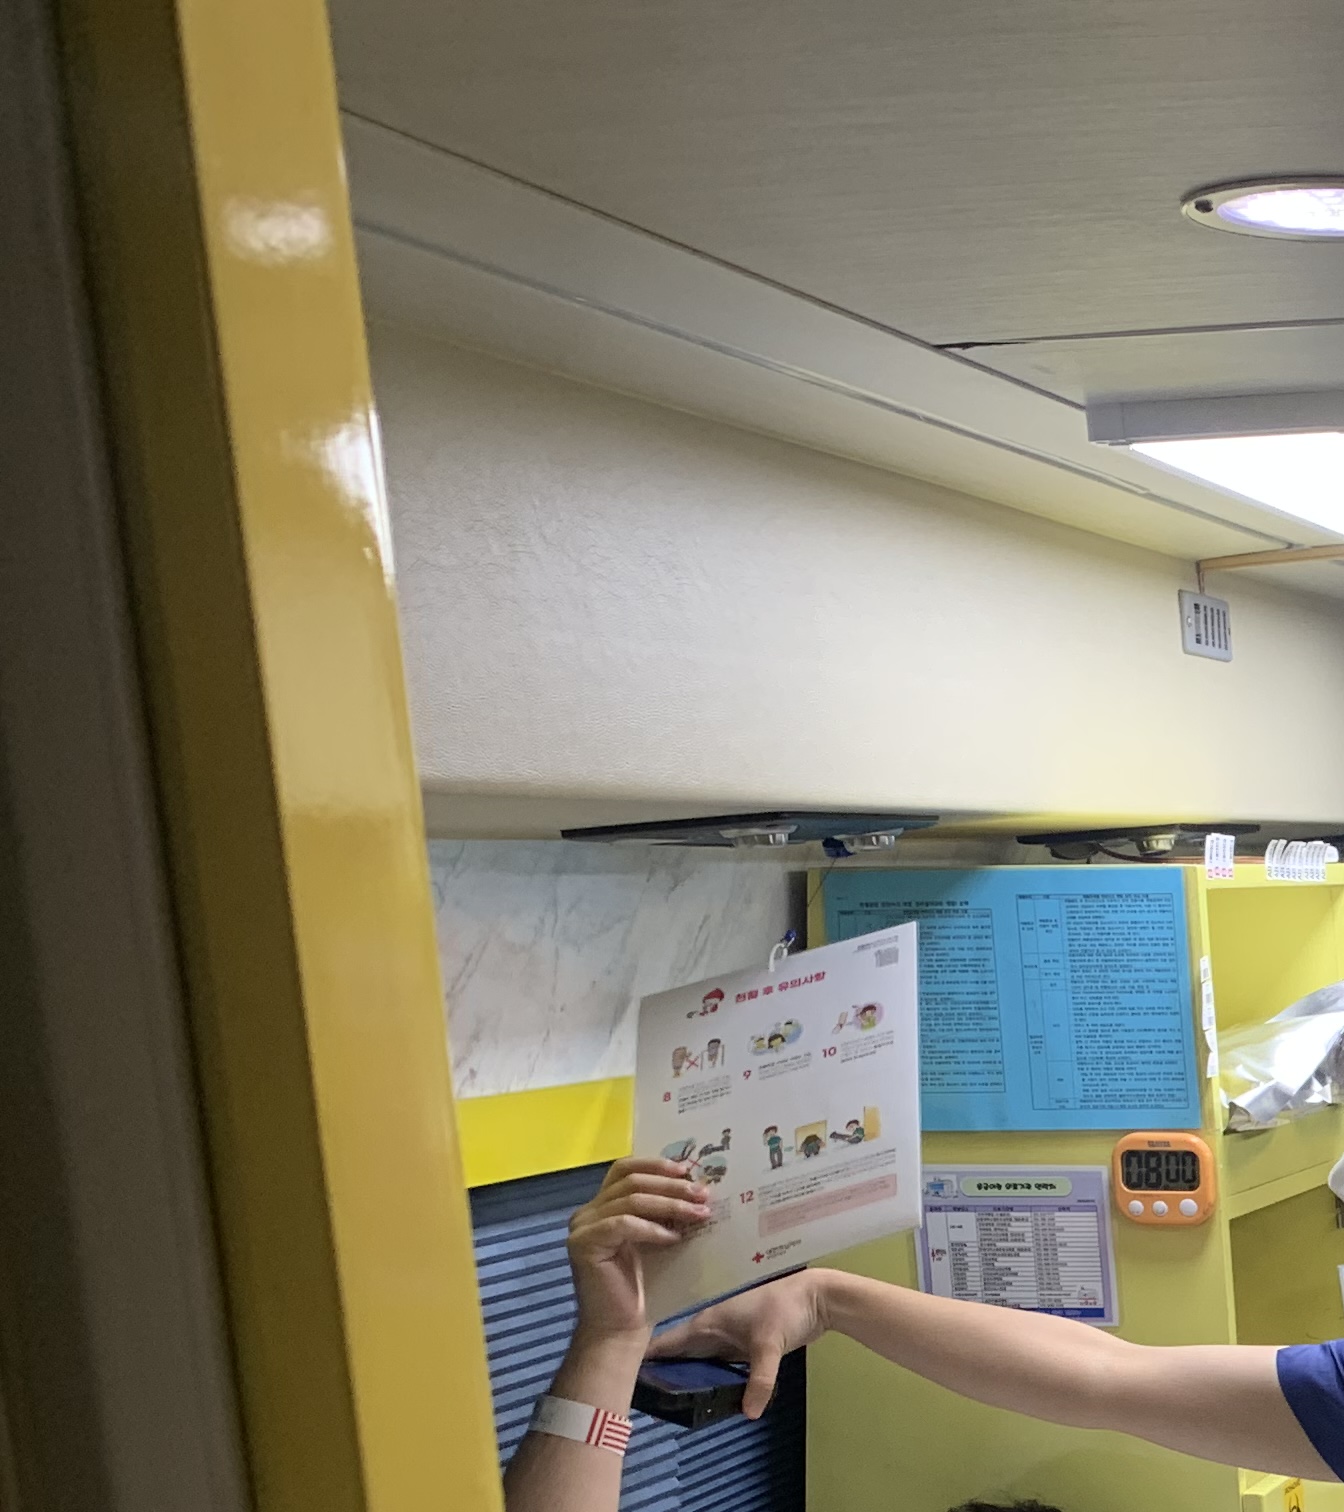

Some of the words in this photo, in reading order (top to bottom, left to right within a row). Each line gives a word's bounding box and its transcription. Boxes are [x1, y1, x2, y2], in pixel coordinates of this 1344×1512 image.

[735, 990, 758, 1003] 헌혈
[762, 986, 774, 996] 후
[777, 971, 826, 992] 유의사항
[822, 1046, 837, 1059] 10
[742, 1070, 752, 1081] 9
[662, 1091, 672, 1103] 8
[740, 1190, 755, 1204] 12
